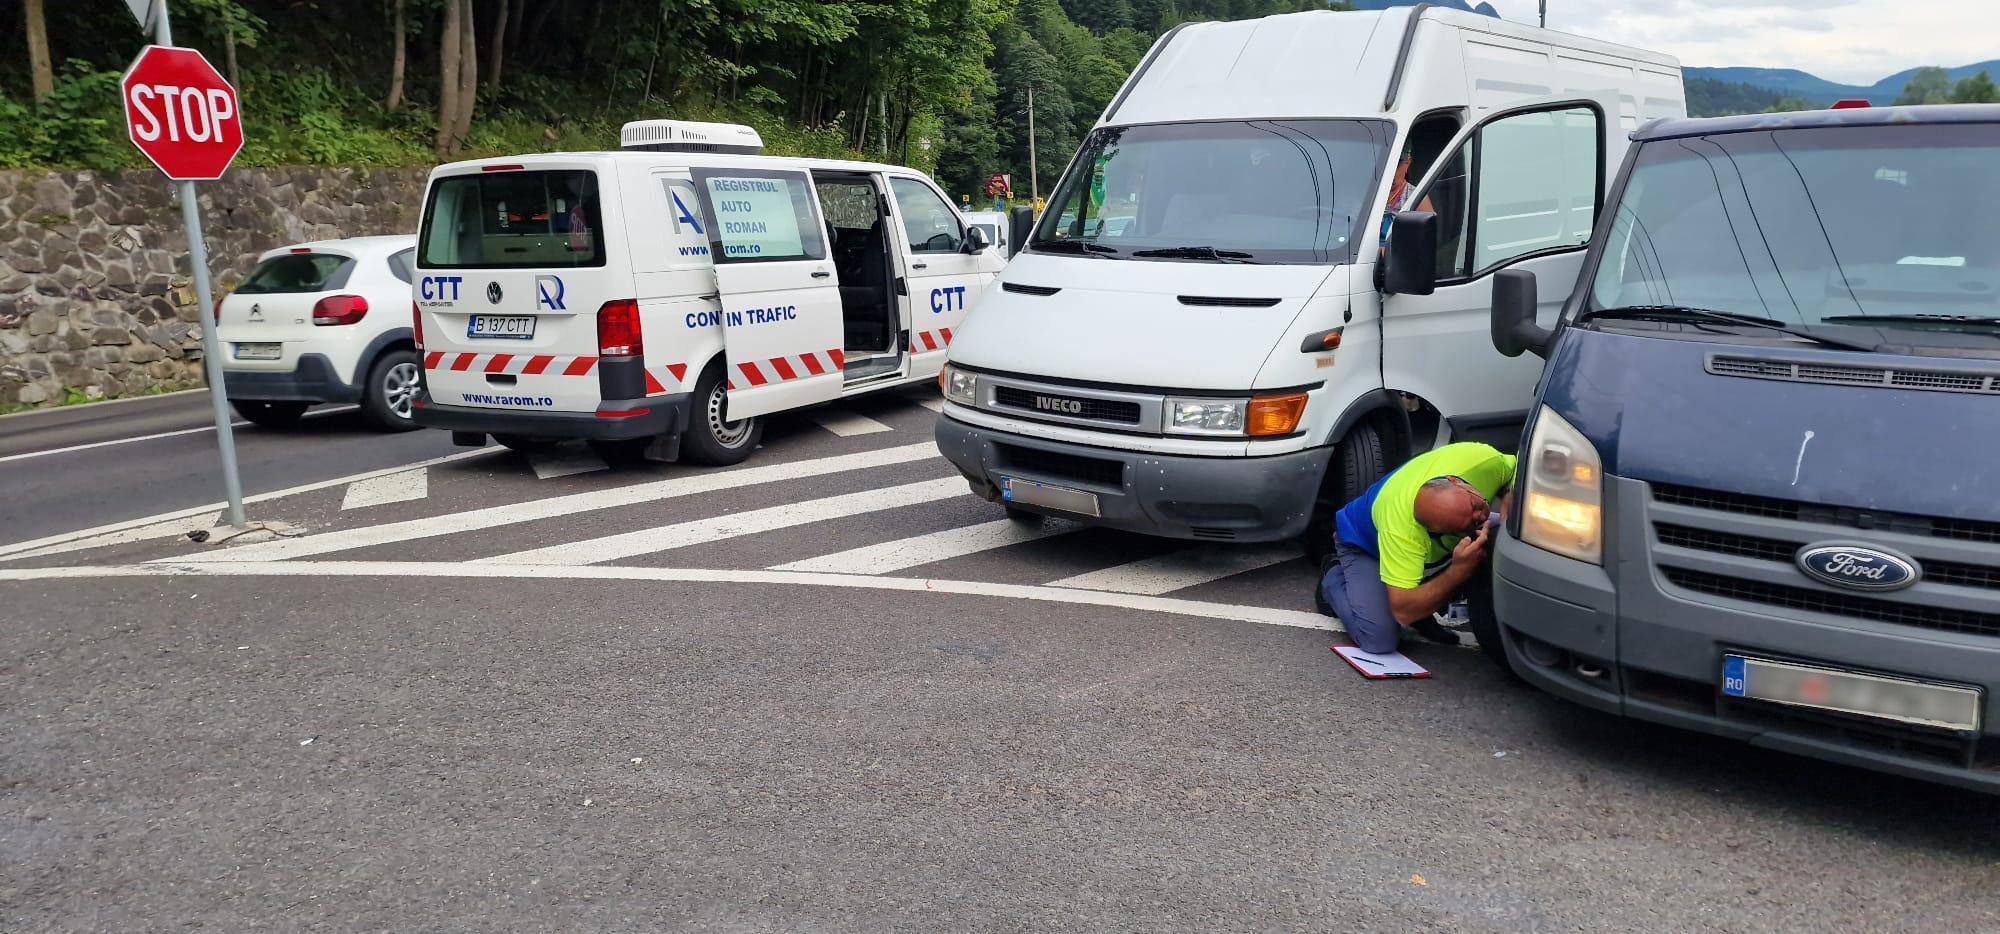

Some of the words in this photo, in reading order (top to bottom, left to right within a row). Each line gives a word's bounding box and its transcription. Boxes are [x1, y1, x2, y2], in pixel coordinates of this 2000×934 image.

[130, 83, 233, 142] STOP
[713, 179, 778, 192] REGISTRUL
[721, 200, 752, 212] AUTO
[725, 221, 767, 233] ROMAN
[421, 276, 462, 300] CTT
[930, 286, 966, 313] CTT
[726, 311, 742, 327] IN
[746, 305, 797, 324] TRAFIC
[476, 318, 484, 331] B
[488, 318, 506, 332] 137
[507, 318, 529, 333] CTT
[462, 393, 553, 406] www.rarom.ro
[1036, 395, 1081, 413] IVECO
[1825, 552, 1888, 579] Ford
[1727, 677, 1743, 690] RO
